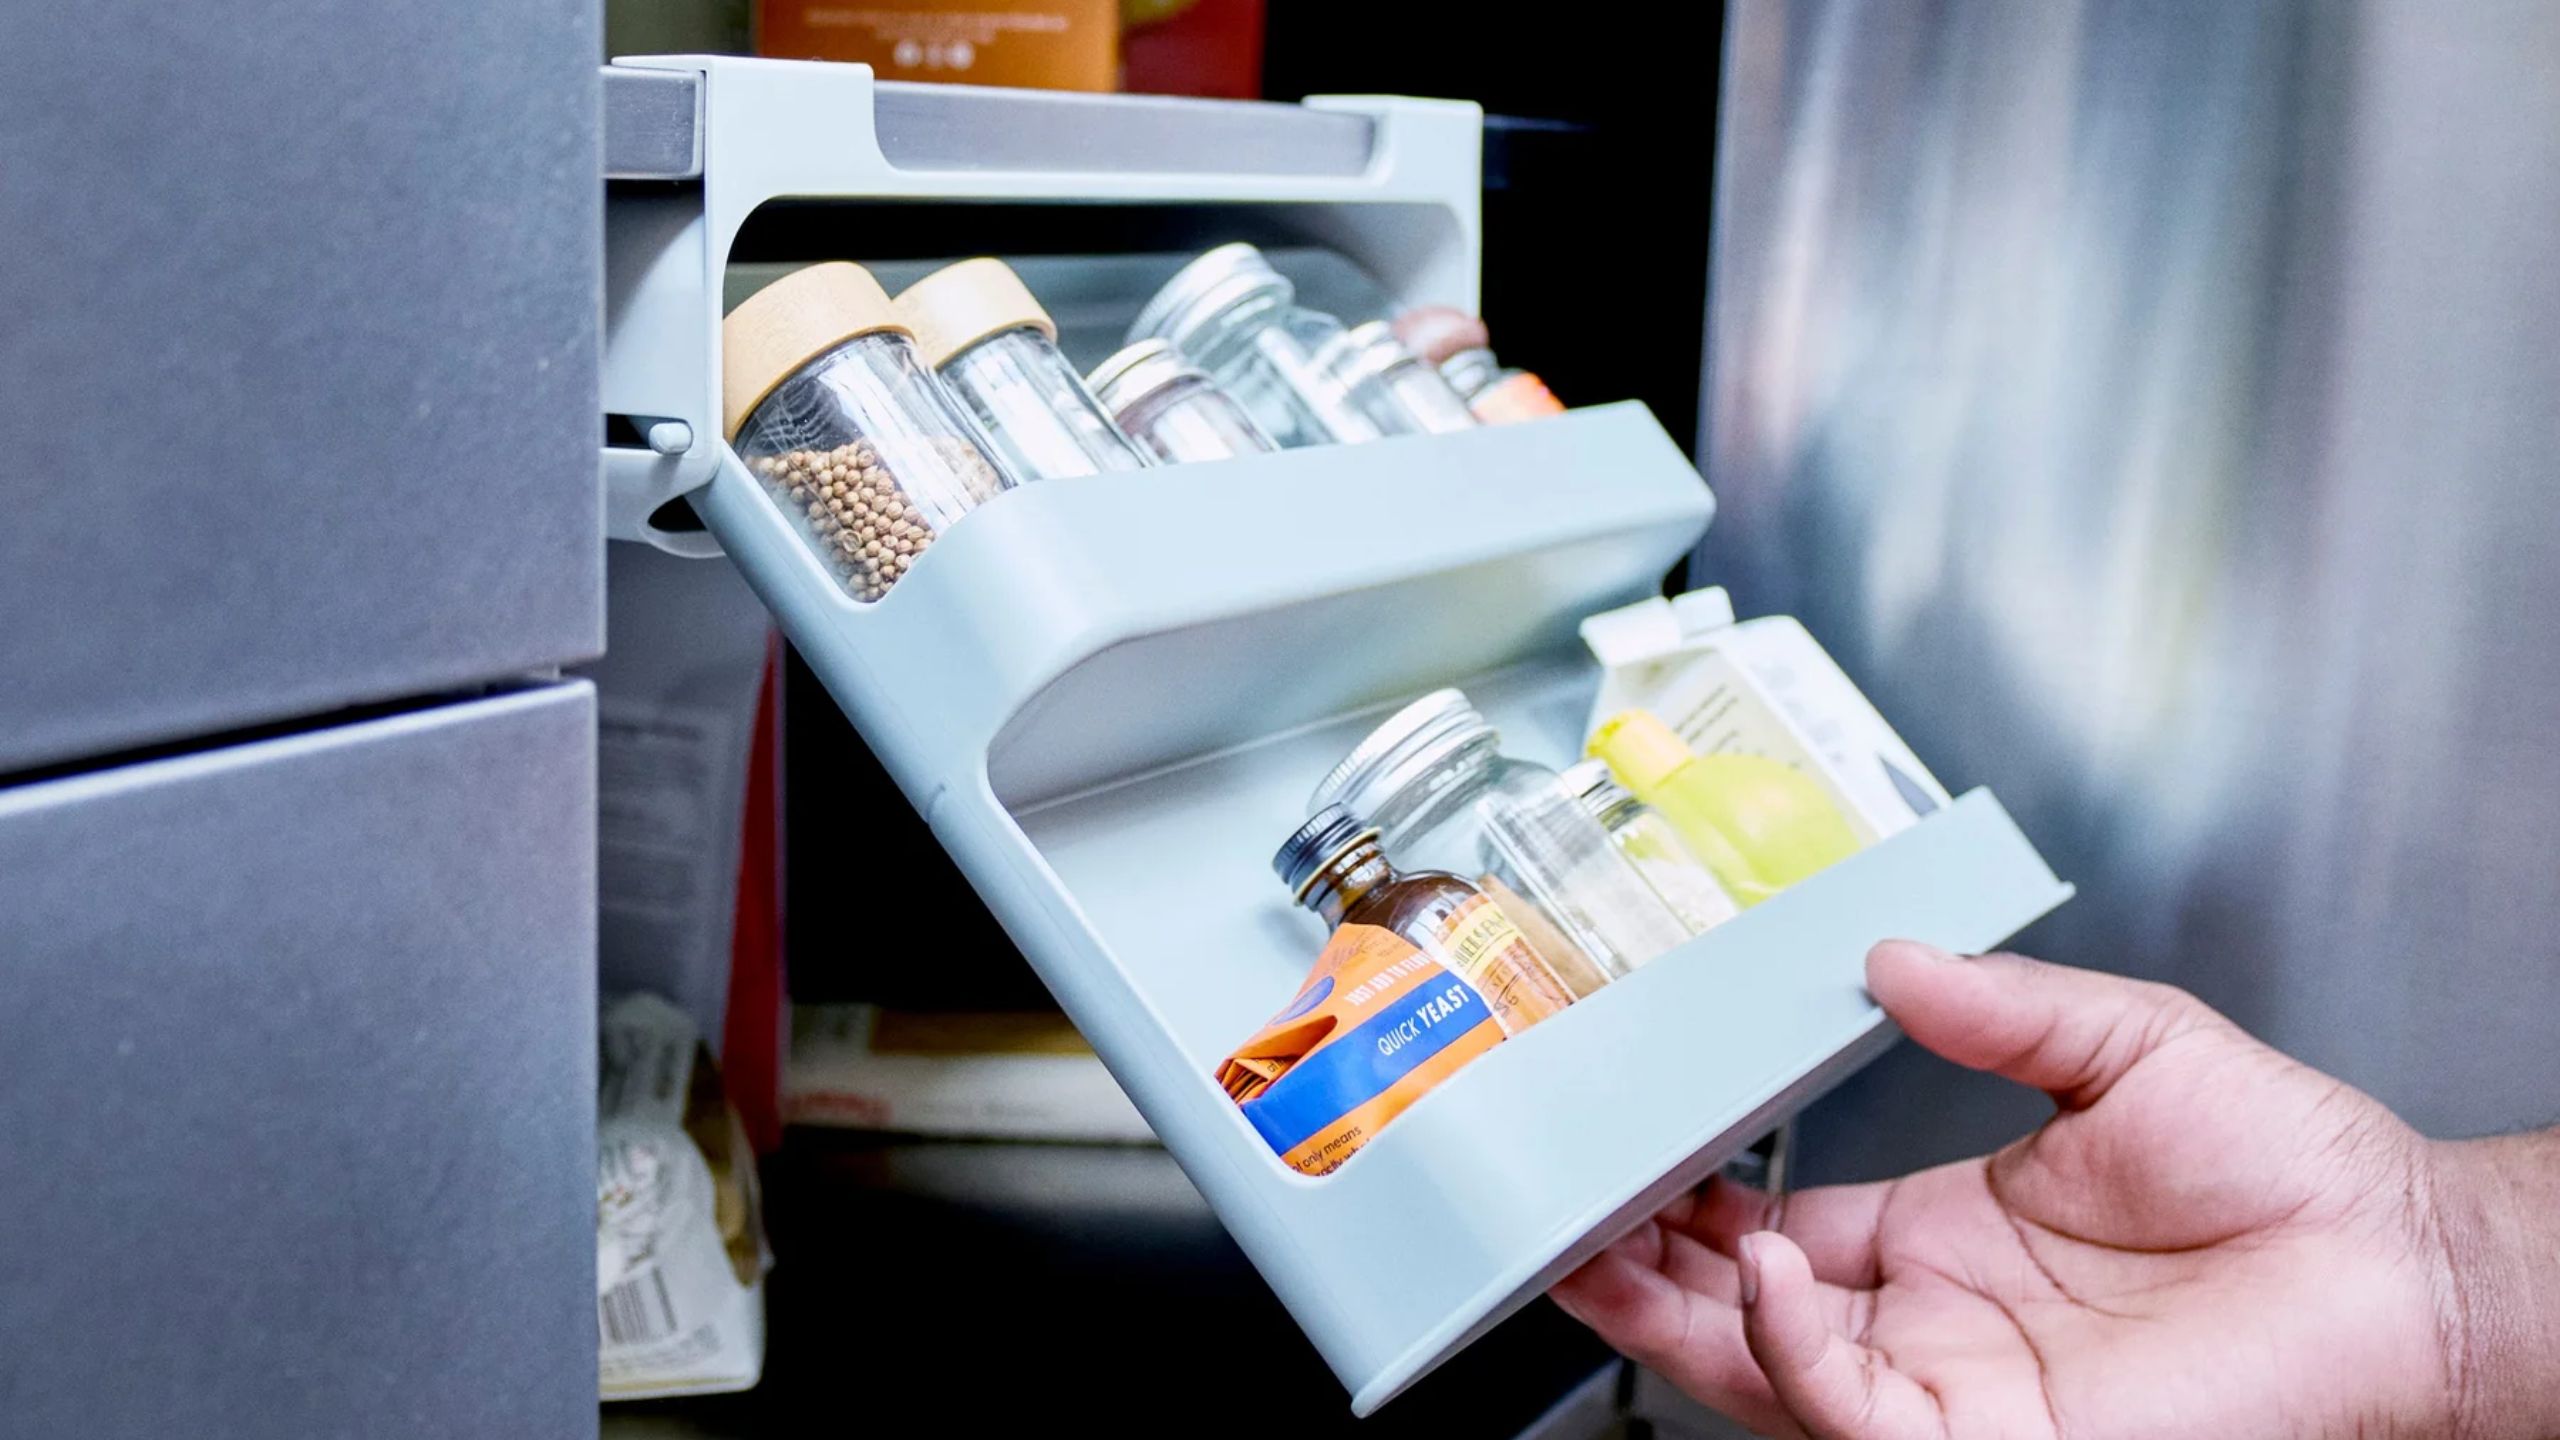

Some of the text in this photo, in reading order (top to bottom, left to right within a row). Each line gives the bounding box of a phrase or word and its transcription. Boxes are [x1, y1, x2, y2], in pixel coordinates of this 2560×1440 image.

[1377, 1017, 1420, 1056] QUICK
[1416, 984, 1470, 1029] YEAST
[1302, 1149, 1324, 1168] only
[1323, 1126, 1362, 1154] means
